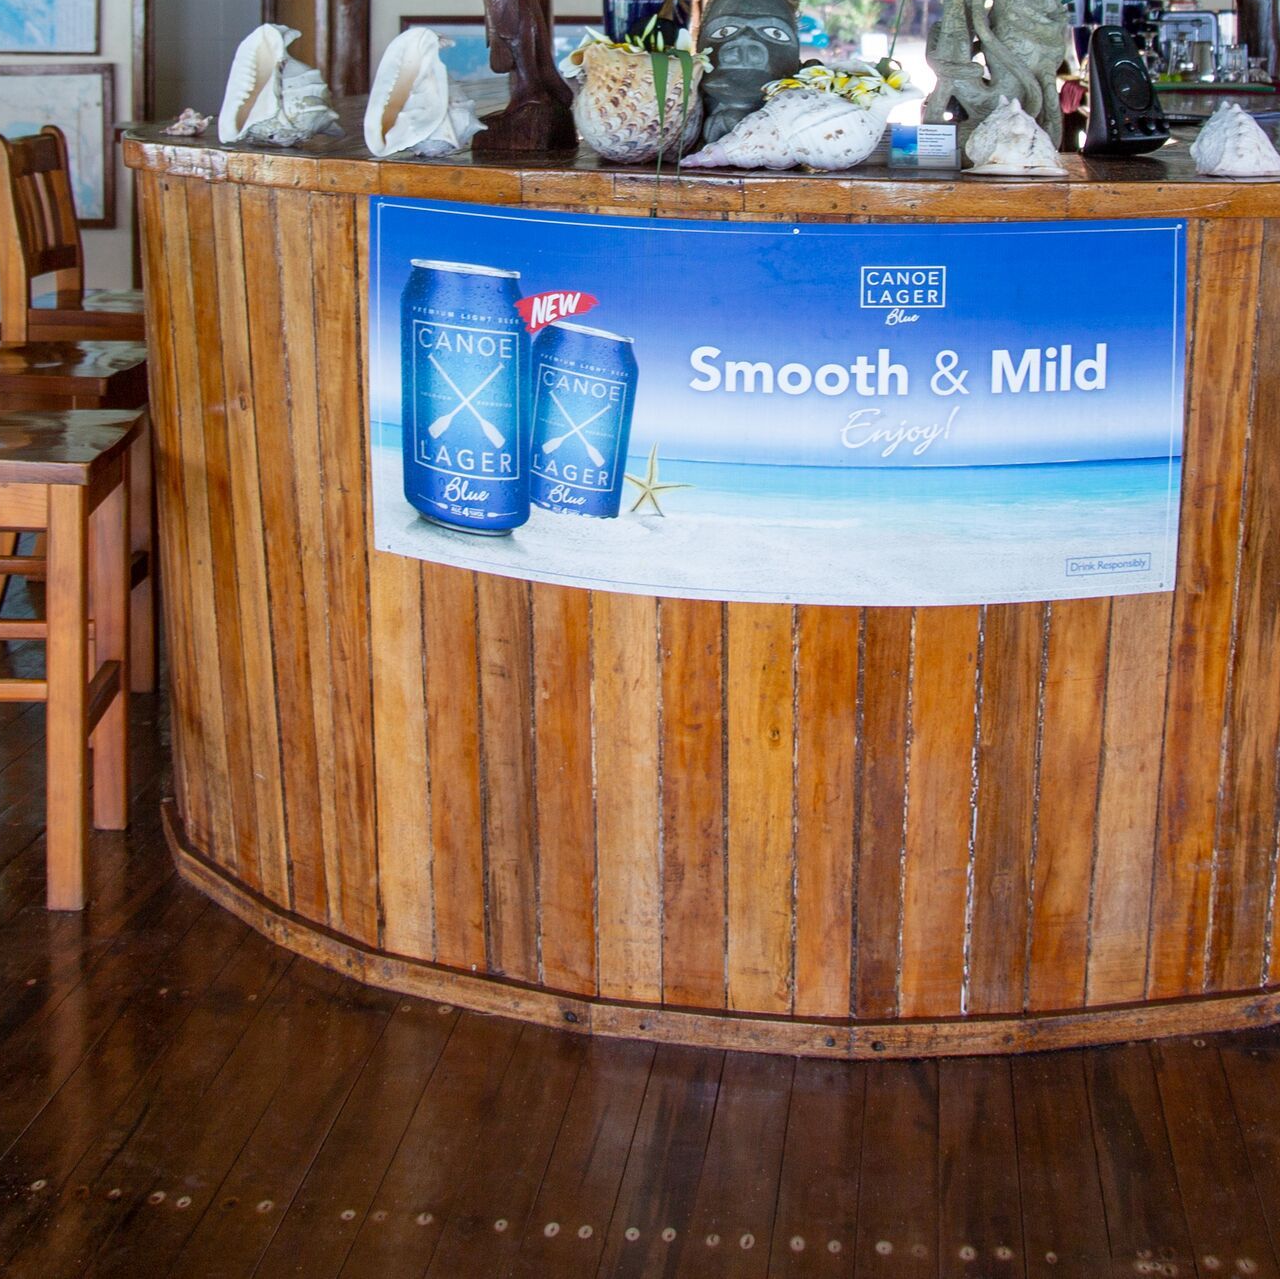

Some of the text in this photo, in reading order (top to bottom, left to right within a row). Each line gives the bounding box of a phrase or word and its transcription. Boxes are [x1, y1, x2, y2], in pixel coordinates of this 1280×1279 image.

[866, 271, 939, 286] CANOE
[530, 291, 581, 328] NEW
[867, 289, 938, 304] LAGER
[412, 305, 454, 318] PREMIUM
[461, 313, 491, 322] LIGHT
[885, 308, 920, 326] Blue
[418, 328, 513, 360] CANOE
[689, 342, 1107, 396] Smooth & Mild
[543, 370, 620, 403] CANOE
[839, 405, 960, 458] Enjoy!
[420, 439, 512, 473] LAGER
[532, 453, 609, 486] LAGER
[443, 476, 490, 502] Blue
[548, 484, 587, 505] Blue
[1070, 557, 1147, 572] Drink Responsibly
